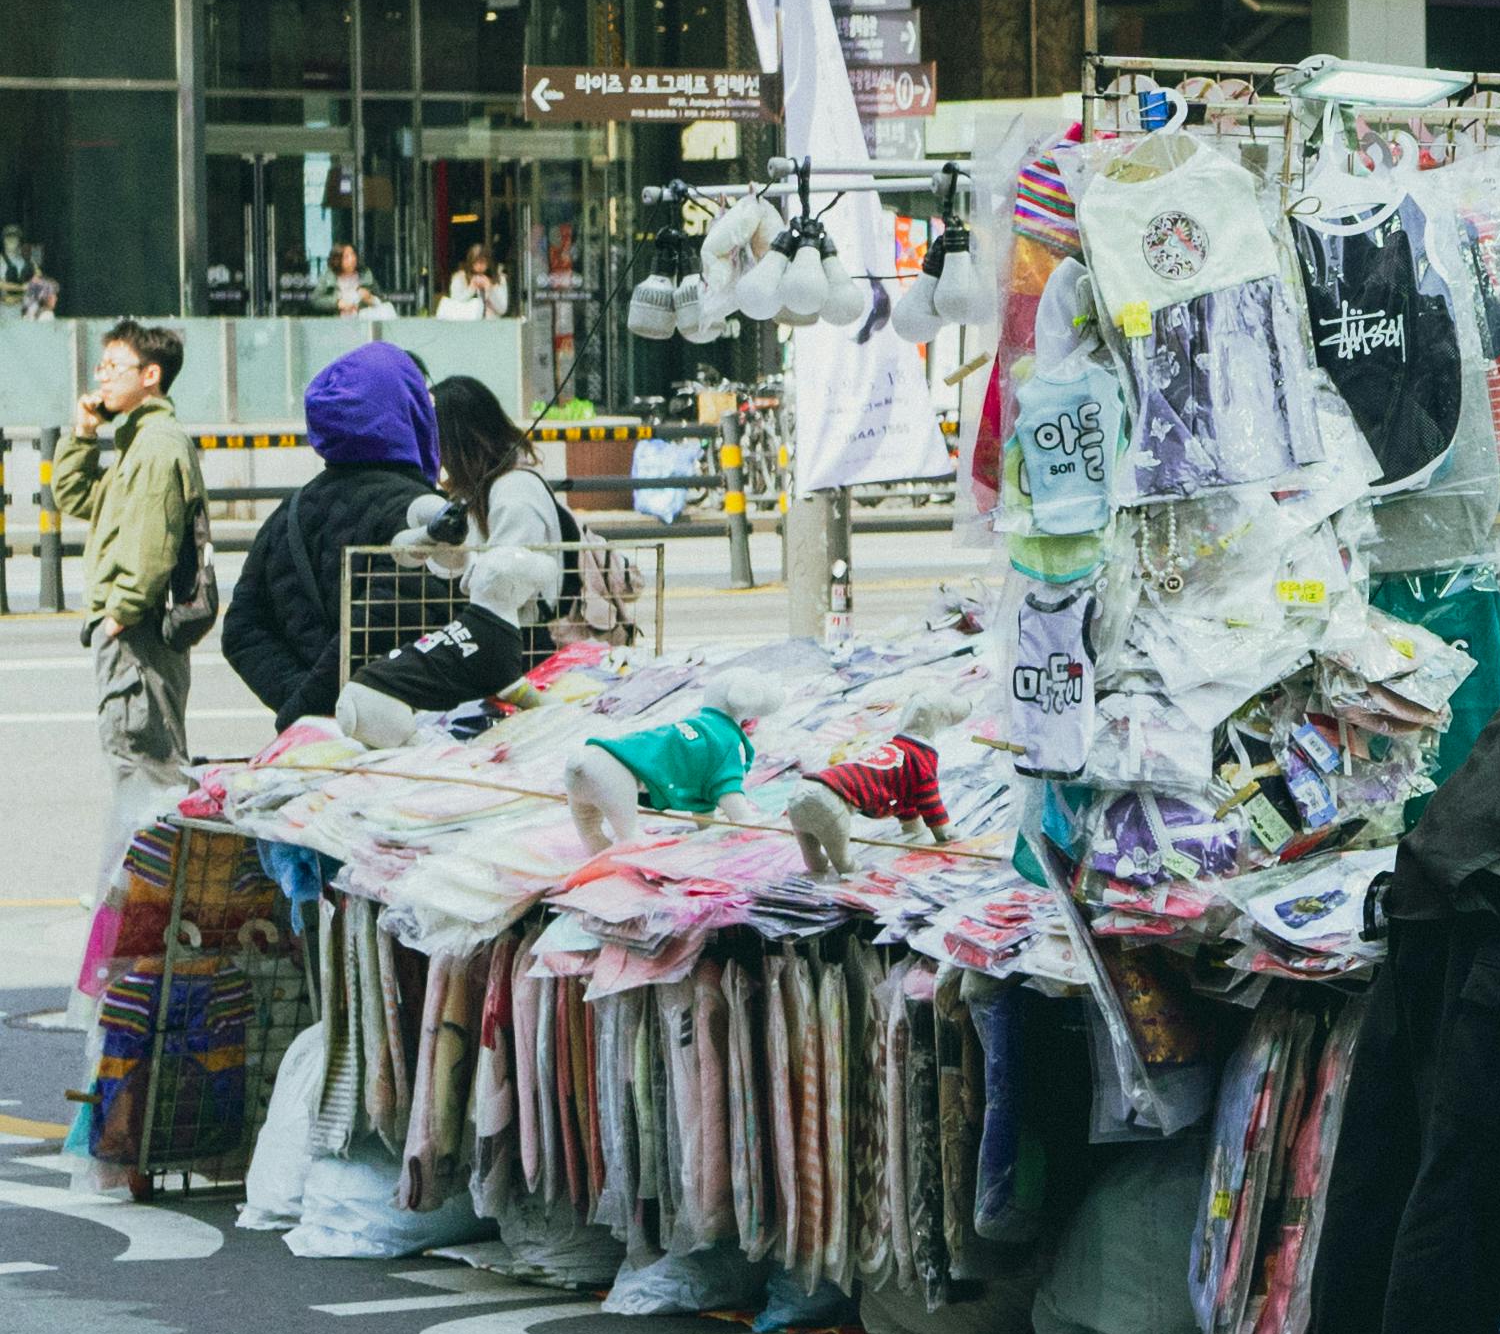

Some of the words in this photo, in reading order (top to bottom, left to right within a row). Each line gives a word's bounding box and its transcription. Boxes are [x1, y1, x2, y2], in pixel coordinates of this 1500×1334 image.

[1034, 402, 1105, 483] 아들
[1048, 459, 1077, 476] son
[1012, 651, 1084, 716] 막둥이
